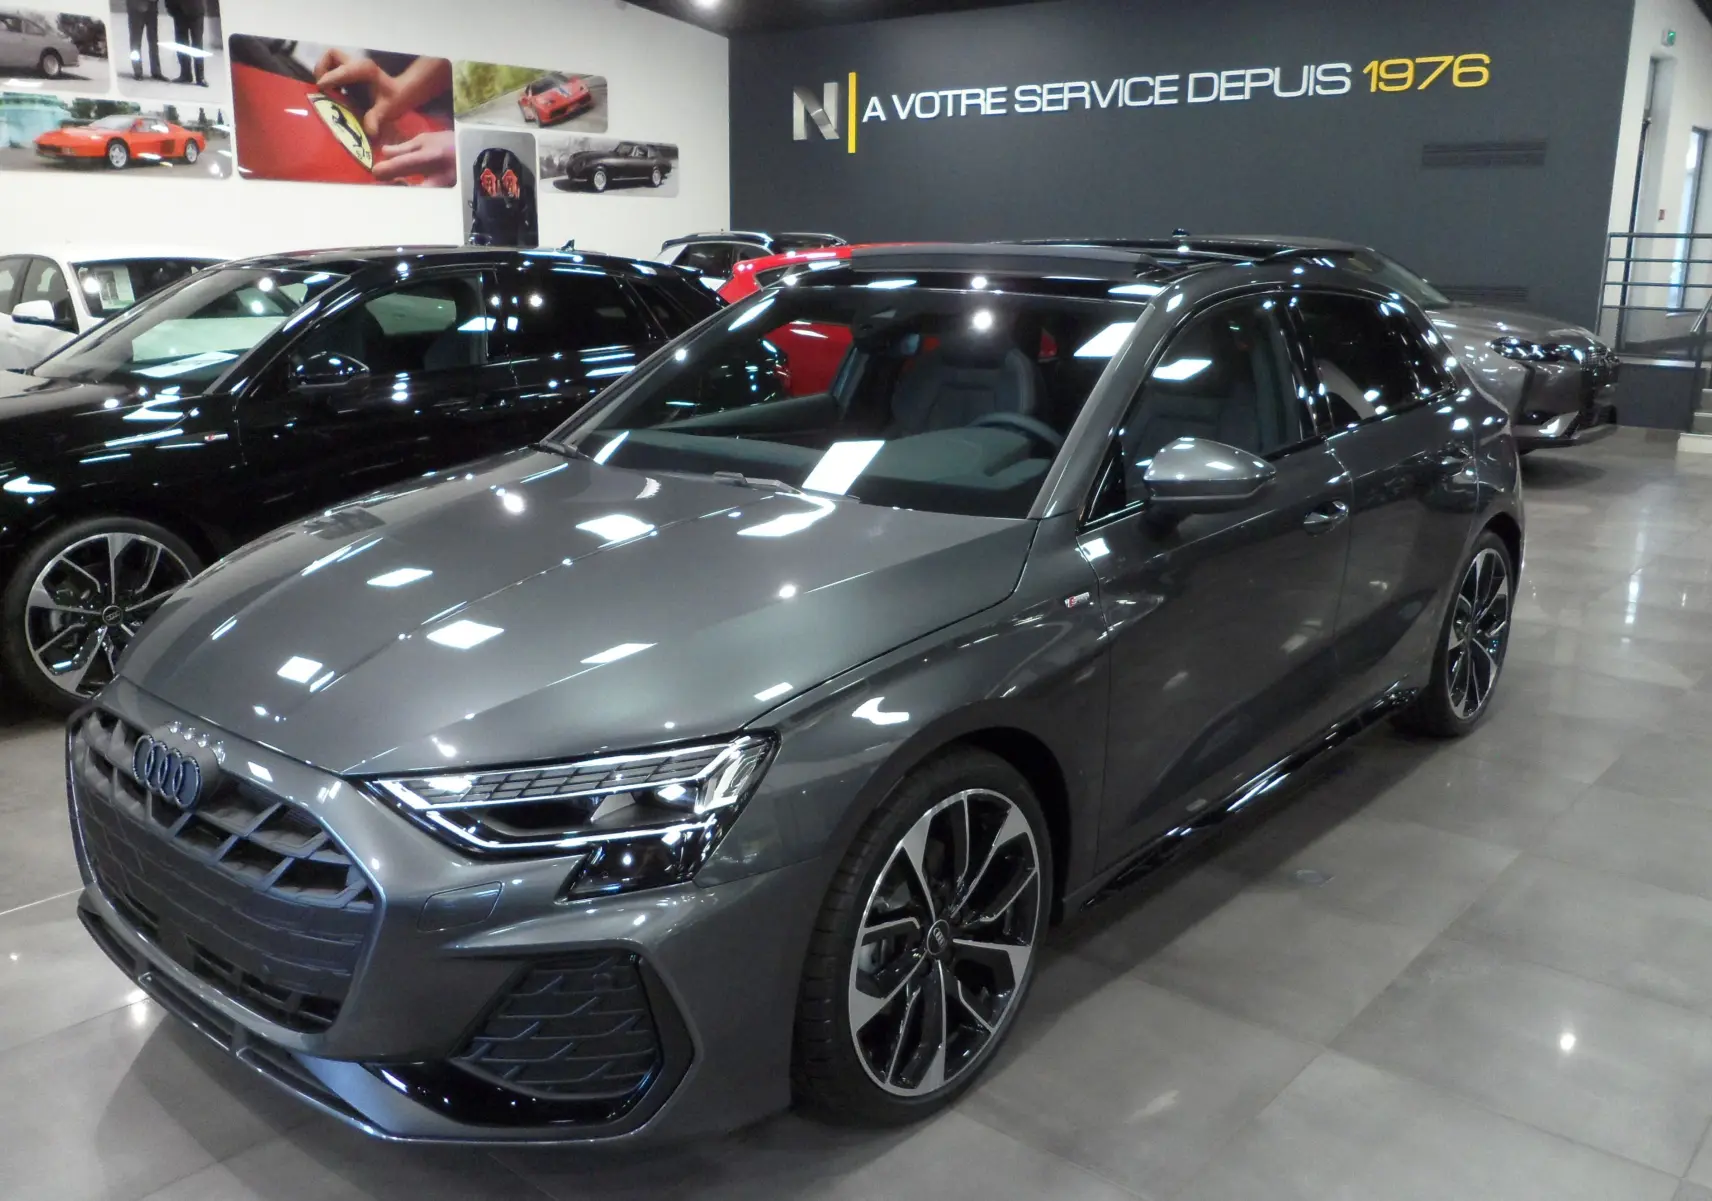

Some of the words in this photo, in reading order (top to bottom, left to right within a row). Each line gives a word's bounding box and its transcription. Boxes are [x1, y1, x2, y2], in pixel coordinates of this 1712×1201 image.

[862, 96, 886, 123] A
[891, 86, 1008, 120] VOTRE
[1014, 74, 1180, 113] SERVICE
[1187, 62, 1352, 104] DEPUIS
[1363, 53, 1491, 93] 1976
